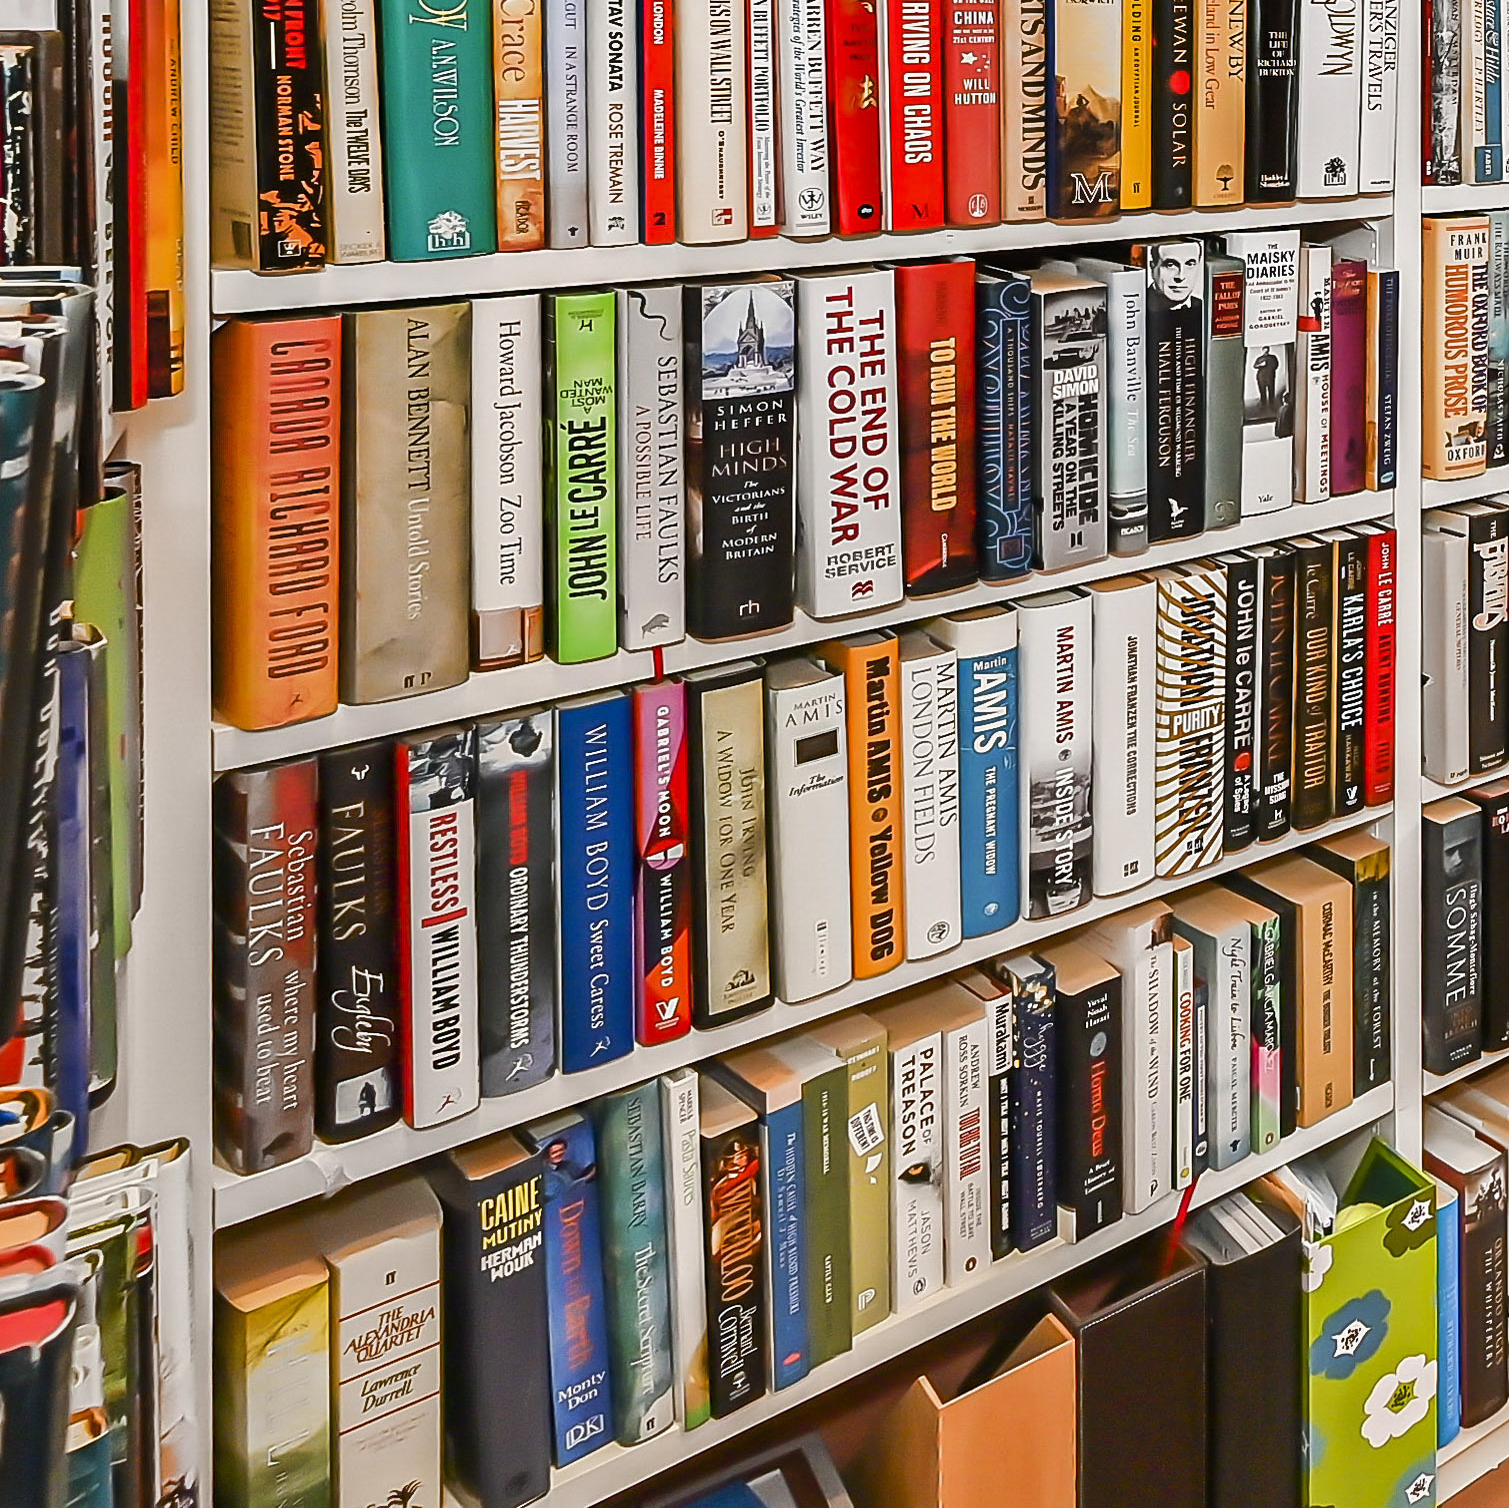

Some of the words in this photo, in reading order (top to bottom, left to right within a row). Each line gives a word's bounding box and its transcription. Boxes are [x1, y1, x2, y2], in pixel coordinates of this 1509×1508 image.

[953, 11, 995, 27] CHINA
[608, 30, 622, 92] SONATA
[904, 69, 931, 99] ON
[963, 79, 990, 91] WILL
[1020, 39, 1045, 105] AND
[609, 104, 623, 138] ROSE
[954, 92, 996, 105] HUTTON
[498, 98, 541, 181] HARVEST
[904, 104, 932, 165] CHAOS
[1020, 109, 1046, 191] MINDS
[1172, 103, 1188, 170] SOLAR
[609, 143, 624, 203] TREMAIN
[1247, 250, 1296, 266] MAISKY
[1450, 233, 1487, 246] FRANK
[1454, 246, 1483, 260] MUIR
[1246, 263, 1295, 279] DIARIES
[406, 318, 430, 378] ALAN
[825, 287, 853, 357] THE
[859, 309, 885, 379] THE
[931, 337, 954, 362] TO
[499, 320, 521, 395] Howard
[932, 365, 955, 403] RUN
[657, 356, 678, 487] SEBASTIAN
[713, 413, 788, 431] HEFFER
[717, 400, 784, 416] SIMON
[827, 366, 857, 459] COLD
[859, 384, 887, 457] END
[932, 406, 956, 442] THE
[406, 386, 432, 492] BENNETT
[496, 398, 522, 485] Jacobson
[560, 417, 608, 500] CARRÉ
[711, 455, 787, 477] MINDS
[719, 439, 780, 458] HIGH
[829, 464, 859, 546] WAR
[862, 464, 889, 510] OF
[932, 445, 957, 511] WORLD
[499, 495, 522, 533] Zoo
[569, 506, 600, 531] LE
[657, 493, 680, 584] FAULKS
[499, 537, 521, 586] Time
[568, 534, 608, 601] JOHN
[824, 556, 897, 579] SERVICE
[827, 543, 895, 567] ROBERT
[1342, 592, 1364, 662] KARLA'S
[973, 656, 1007, 671] Martin
[1056, 626, 1074, 692] MARTIN
[864, 656, 892, 735] Martin
[910, 667, 935, 778] LONDON
[935, 661, 957, 757] MARTIN
[971, 672, 1004, 754] AMIS
[1056, 698, 1074, 745] AMIS
[1173, 706, 1220, 735] PURITY
[1341, 665, 1364, 730] CHOICE
[656, 706, 671, 785] GABRIEL'S
[865, 739, 892, 803] AMIS
[584, 723, 611, 830] WILLIAM
[937, 763, 959, 829] AMIS
[1054, 766, 1074, 826] INSIDE
[658, 792, 672, 838] MOON
[912, 782, 936, 865] FIELDS
[288, 830, 313, 941] Sebastian
[332, 802, 367, 943] FAULKS
[428, 813, 458, 911] RESTLESS
[585, 841, 610, 911] BOYD
[1054, 830, 1075, 887] STORY
[247, 822, 283, 968] FAULKS
[658, 874, 672, 942] WILLIAM
[430, 924, 462, 1015] WILLIAM
[588, 918, 611, 967] Sweet
[659, 947, 674, 987] BOYD
[1446, 888, 1466, 1007] SOMME
[332, 966, 394, 1054] Engleby
[588, 972, 610, 1030] Caress
[1179, 991, 1193, 1051] COOKING
[432, 1017, 463, 1071] BOYD
[995, 1001, 1011, 1076] Murakami
[1179, 1053, 1192, 1074] FOR
[901, 1054, 919, 1159] TREASON
[917, 1047, 936, 1127] PALACE
[1179, 1078, 1192, 1105] ONE
[480, 1232, 542, 1270] HERMAN
[482, 1213, 542, 1250] MUTINY
[490, 1253, 535, 1282] WOUK
[361, 1363, 421, 1397] Lawrence
[362, 1382, 414, 1413] Durrell
[557, 1371, 606, 1403] Monty
[567, 1387, 598, 1411] Don
